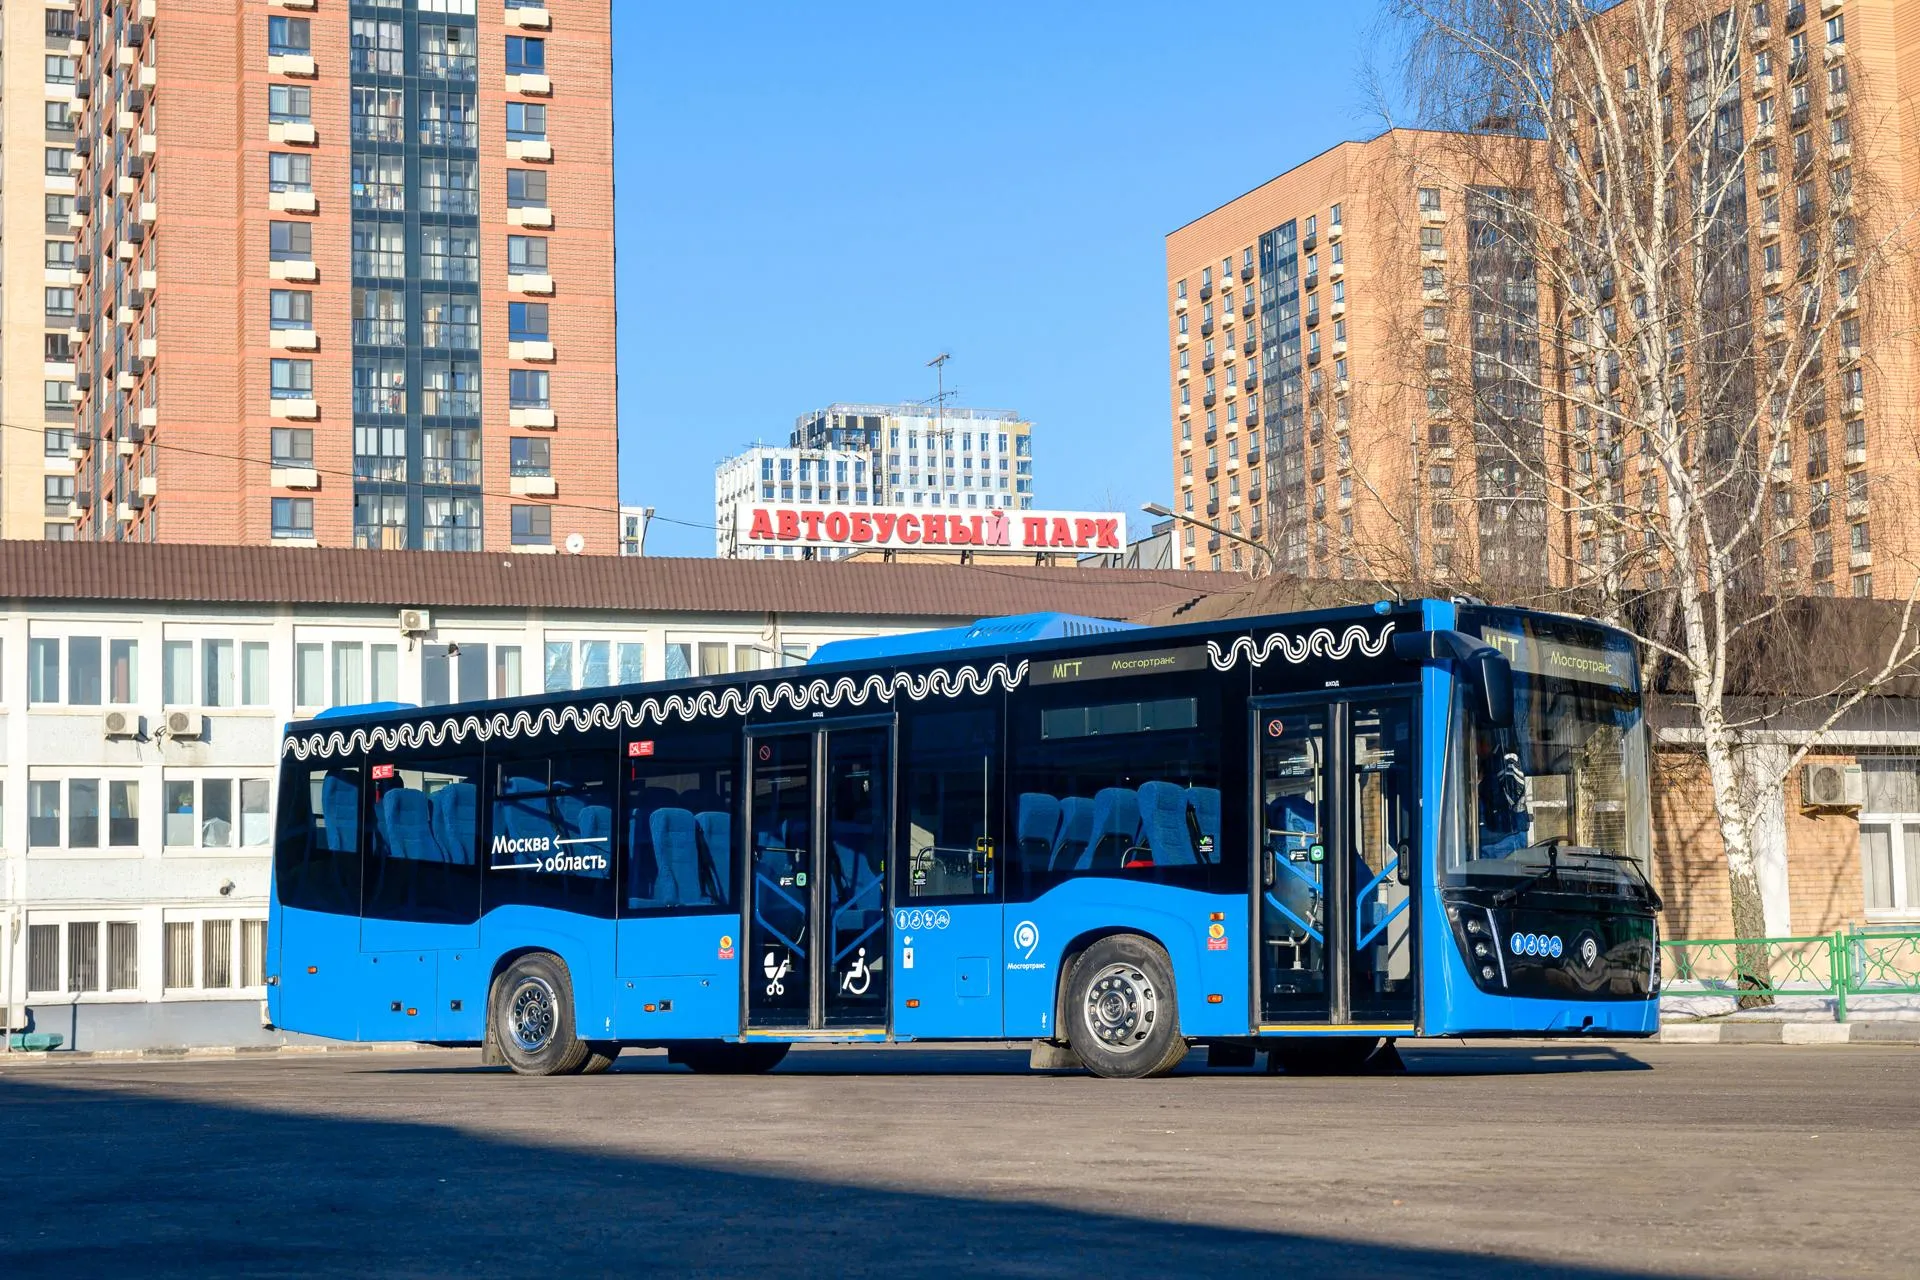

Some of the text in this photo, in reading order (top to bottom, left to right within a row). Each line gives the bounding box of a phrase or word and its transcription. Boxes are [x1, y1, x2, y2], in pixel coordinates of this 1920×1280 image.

[750, 508, 1119, 548] АВТОБУСНЫЙ ПАРК
[1052, 656, 1176, 678] МГТ Мосгортранс
[1550, 651, 1612, 674] Мосгортранс
[492, 836, 549, 854] Москва
[546, 852, 607, 872] область
[1007, 962, 1046, 970] Мосгортранс
